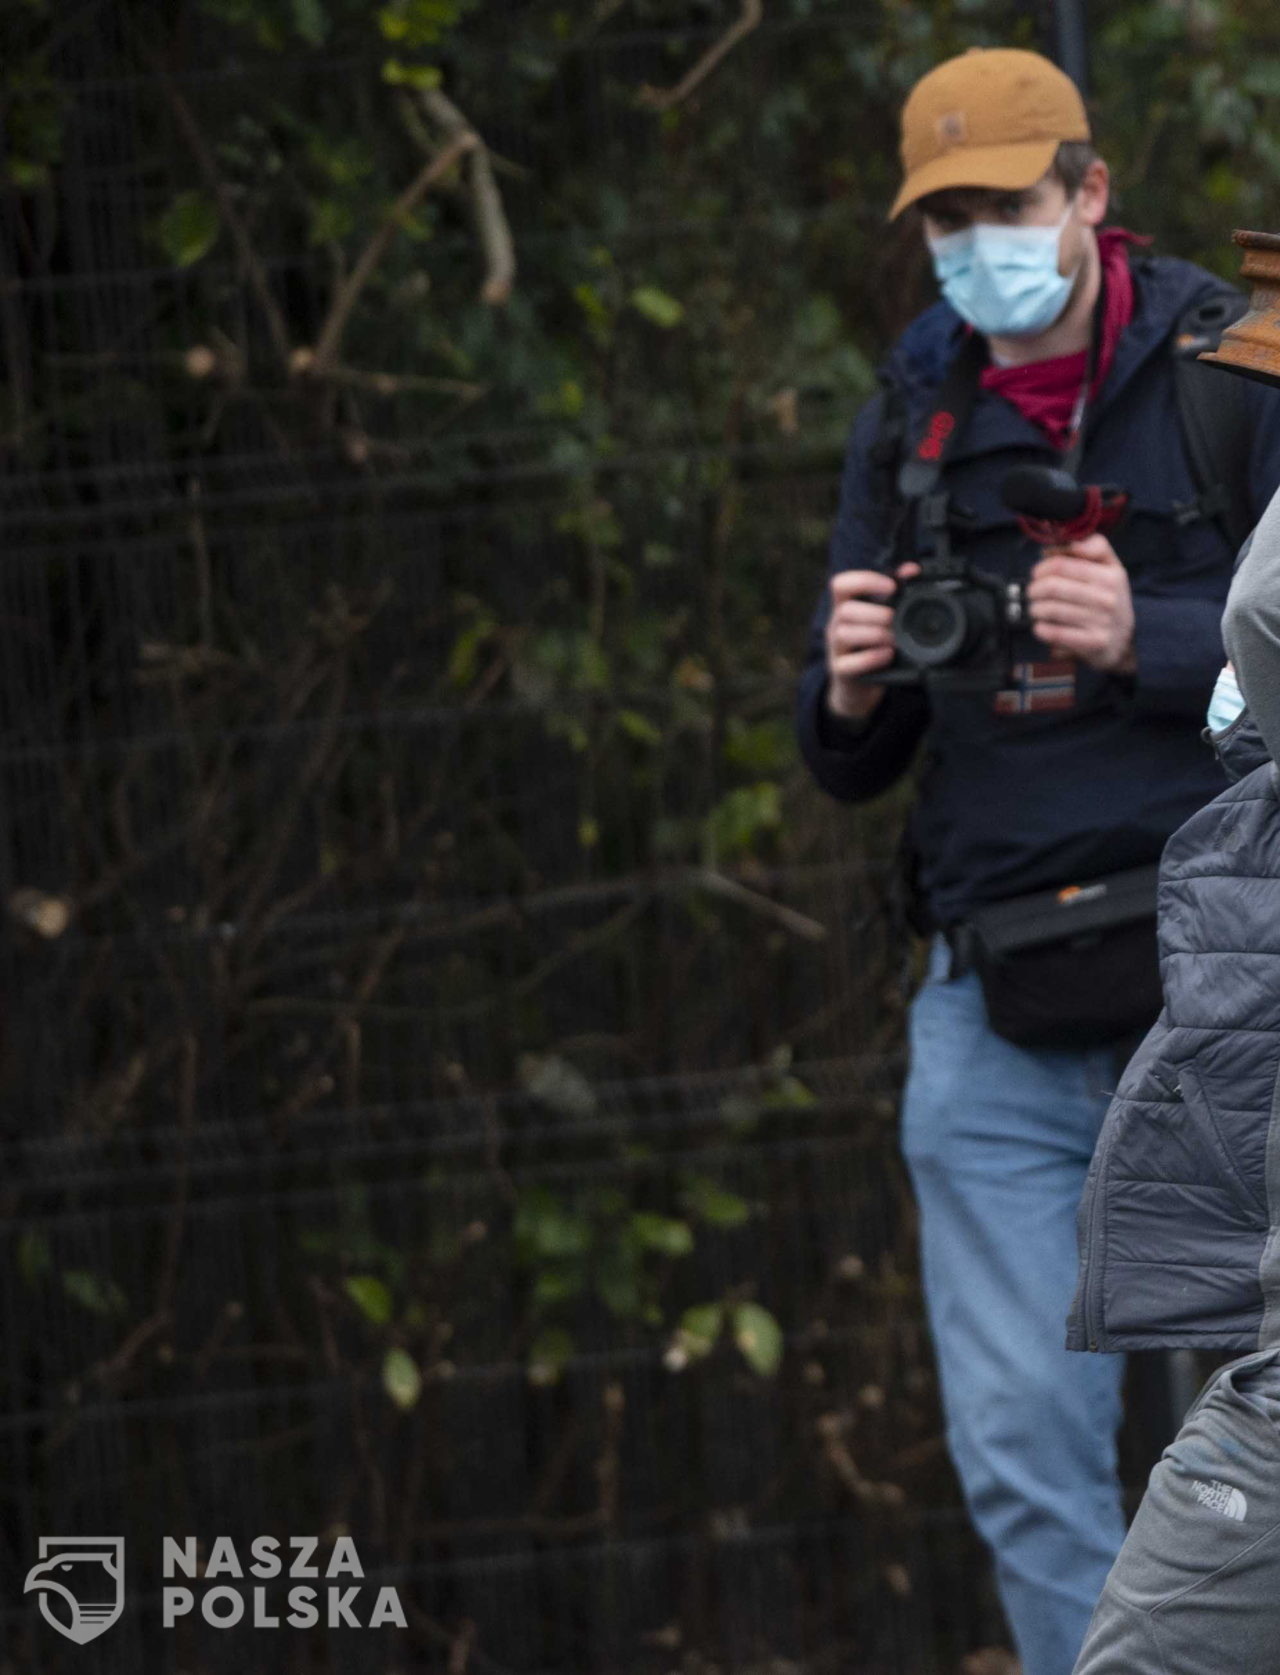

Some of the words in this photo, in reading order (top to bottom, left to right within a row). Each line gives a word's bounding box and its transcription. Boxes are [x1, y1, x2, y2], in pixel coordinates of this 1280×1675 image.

[1191, 1480, 1229, 1504] NORTH
[1210, 1479, 1232, 1493] THE
[1197, 1492, 1225, 1513] FACE
